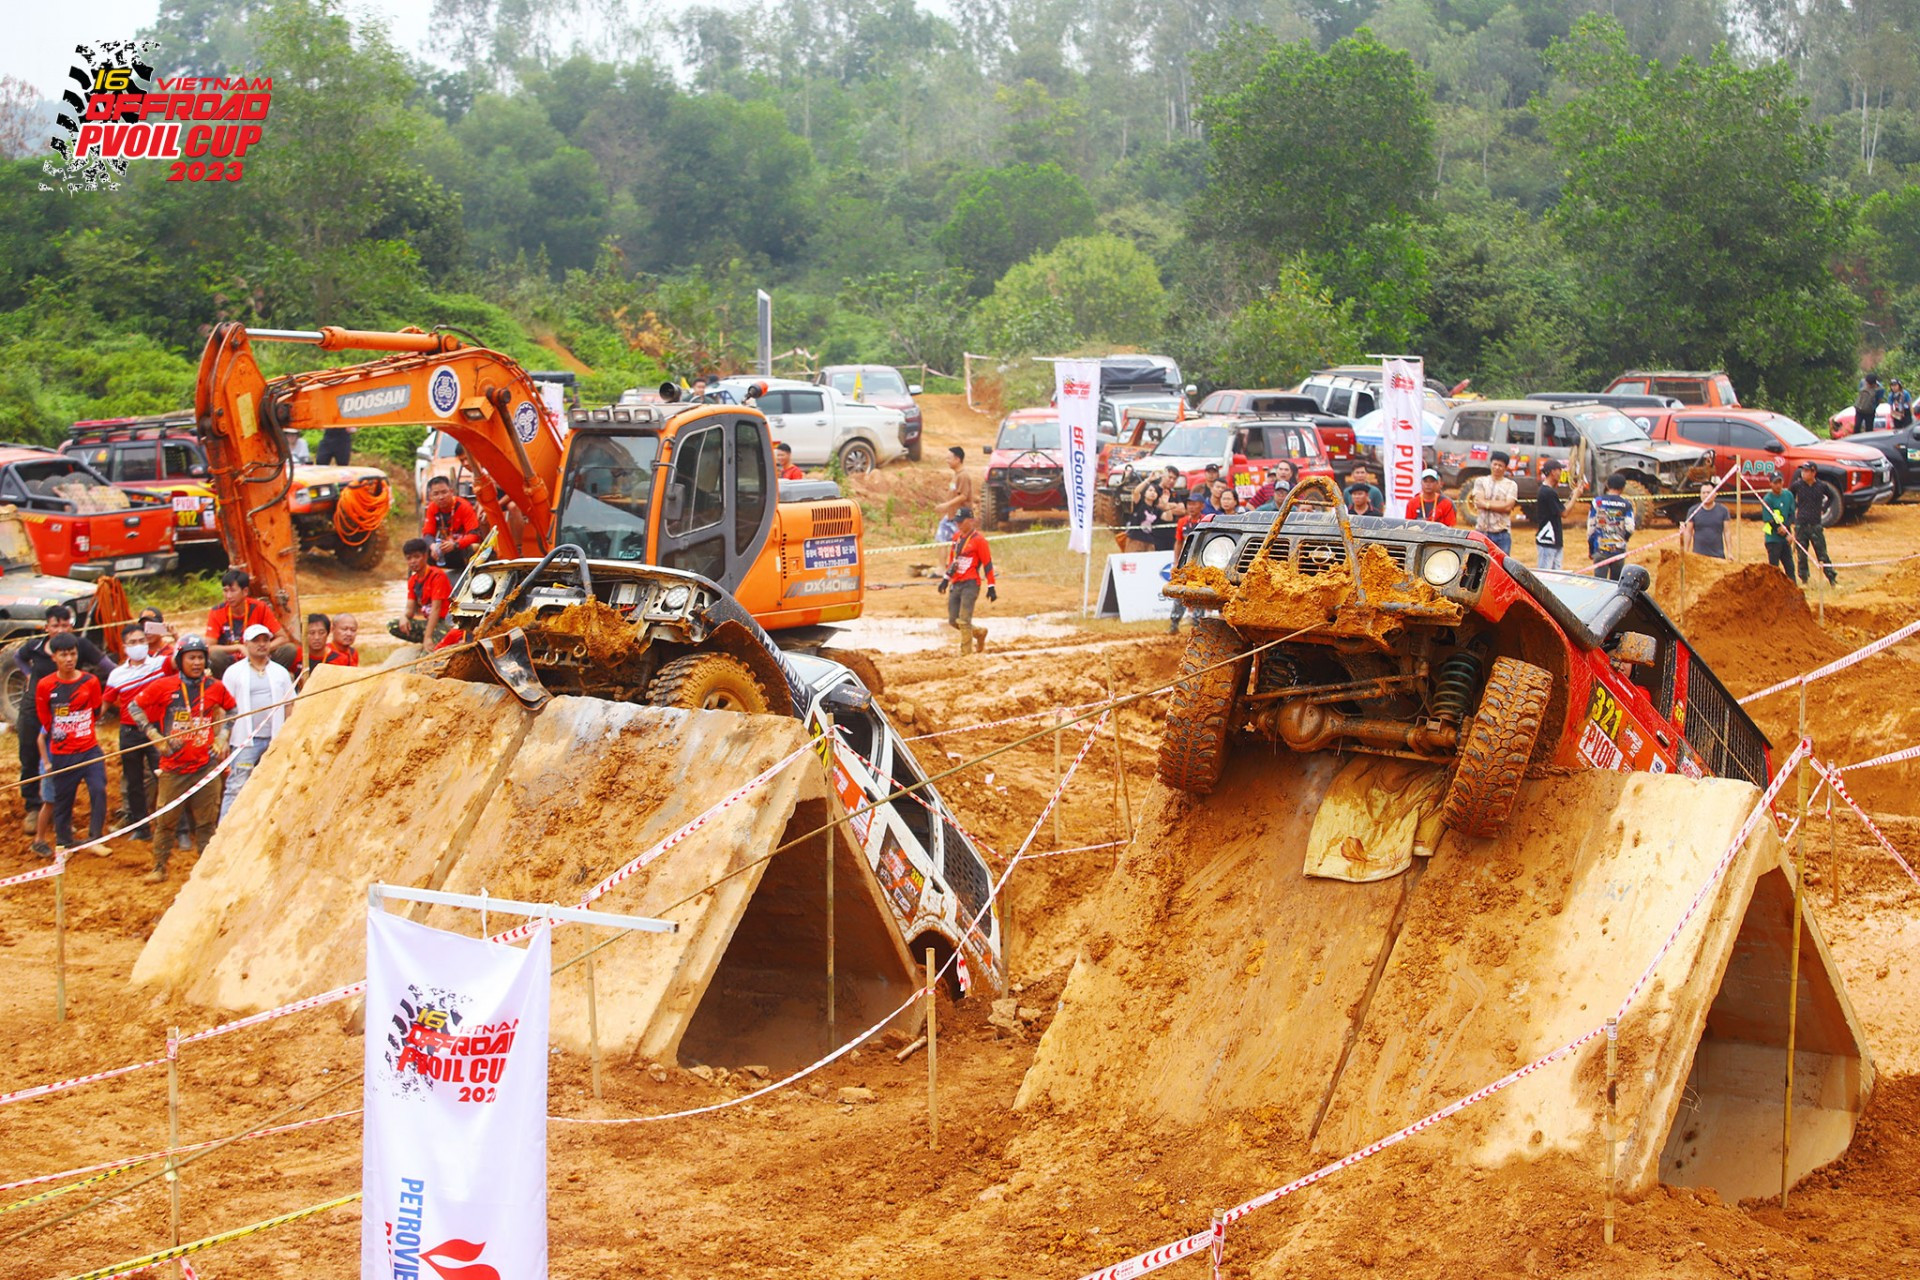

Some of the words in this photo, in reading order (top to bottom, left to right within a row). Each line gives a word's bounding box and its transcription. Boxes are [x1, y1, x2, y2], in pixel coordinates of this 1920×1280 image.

[343, 389, 406, 412] DOOSAN
[1234, 472, 1251, 486] 305
[177, 511, 198, 526] 312
[55, 706, 69, 716] 16
[173, 711, 189, 722] 16
[1592, 687, 1623, 740] 321
[911, 867, 924, 889] 320
[417, 1008, 449, 1029] 16
[469, 1058, 507, 1084] CU
